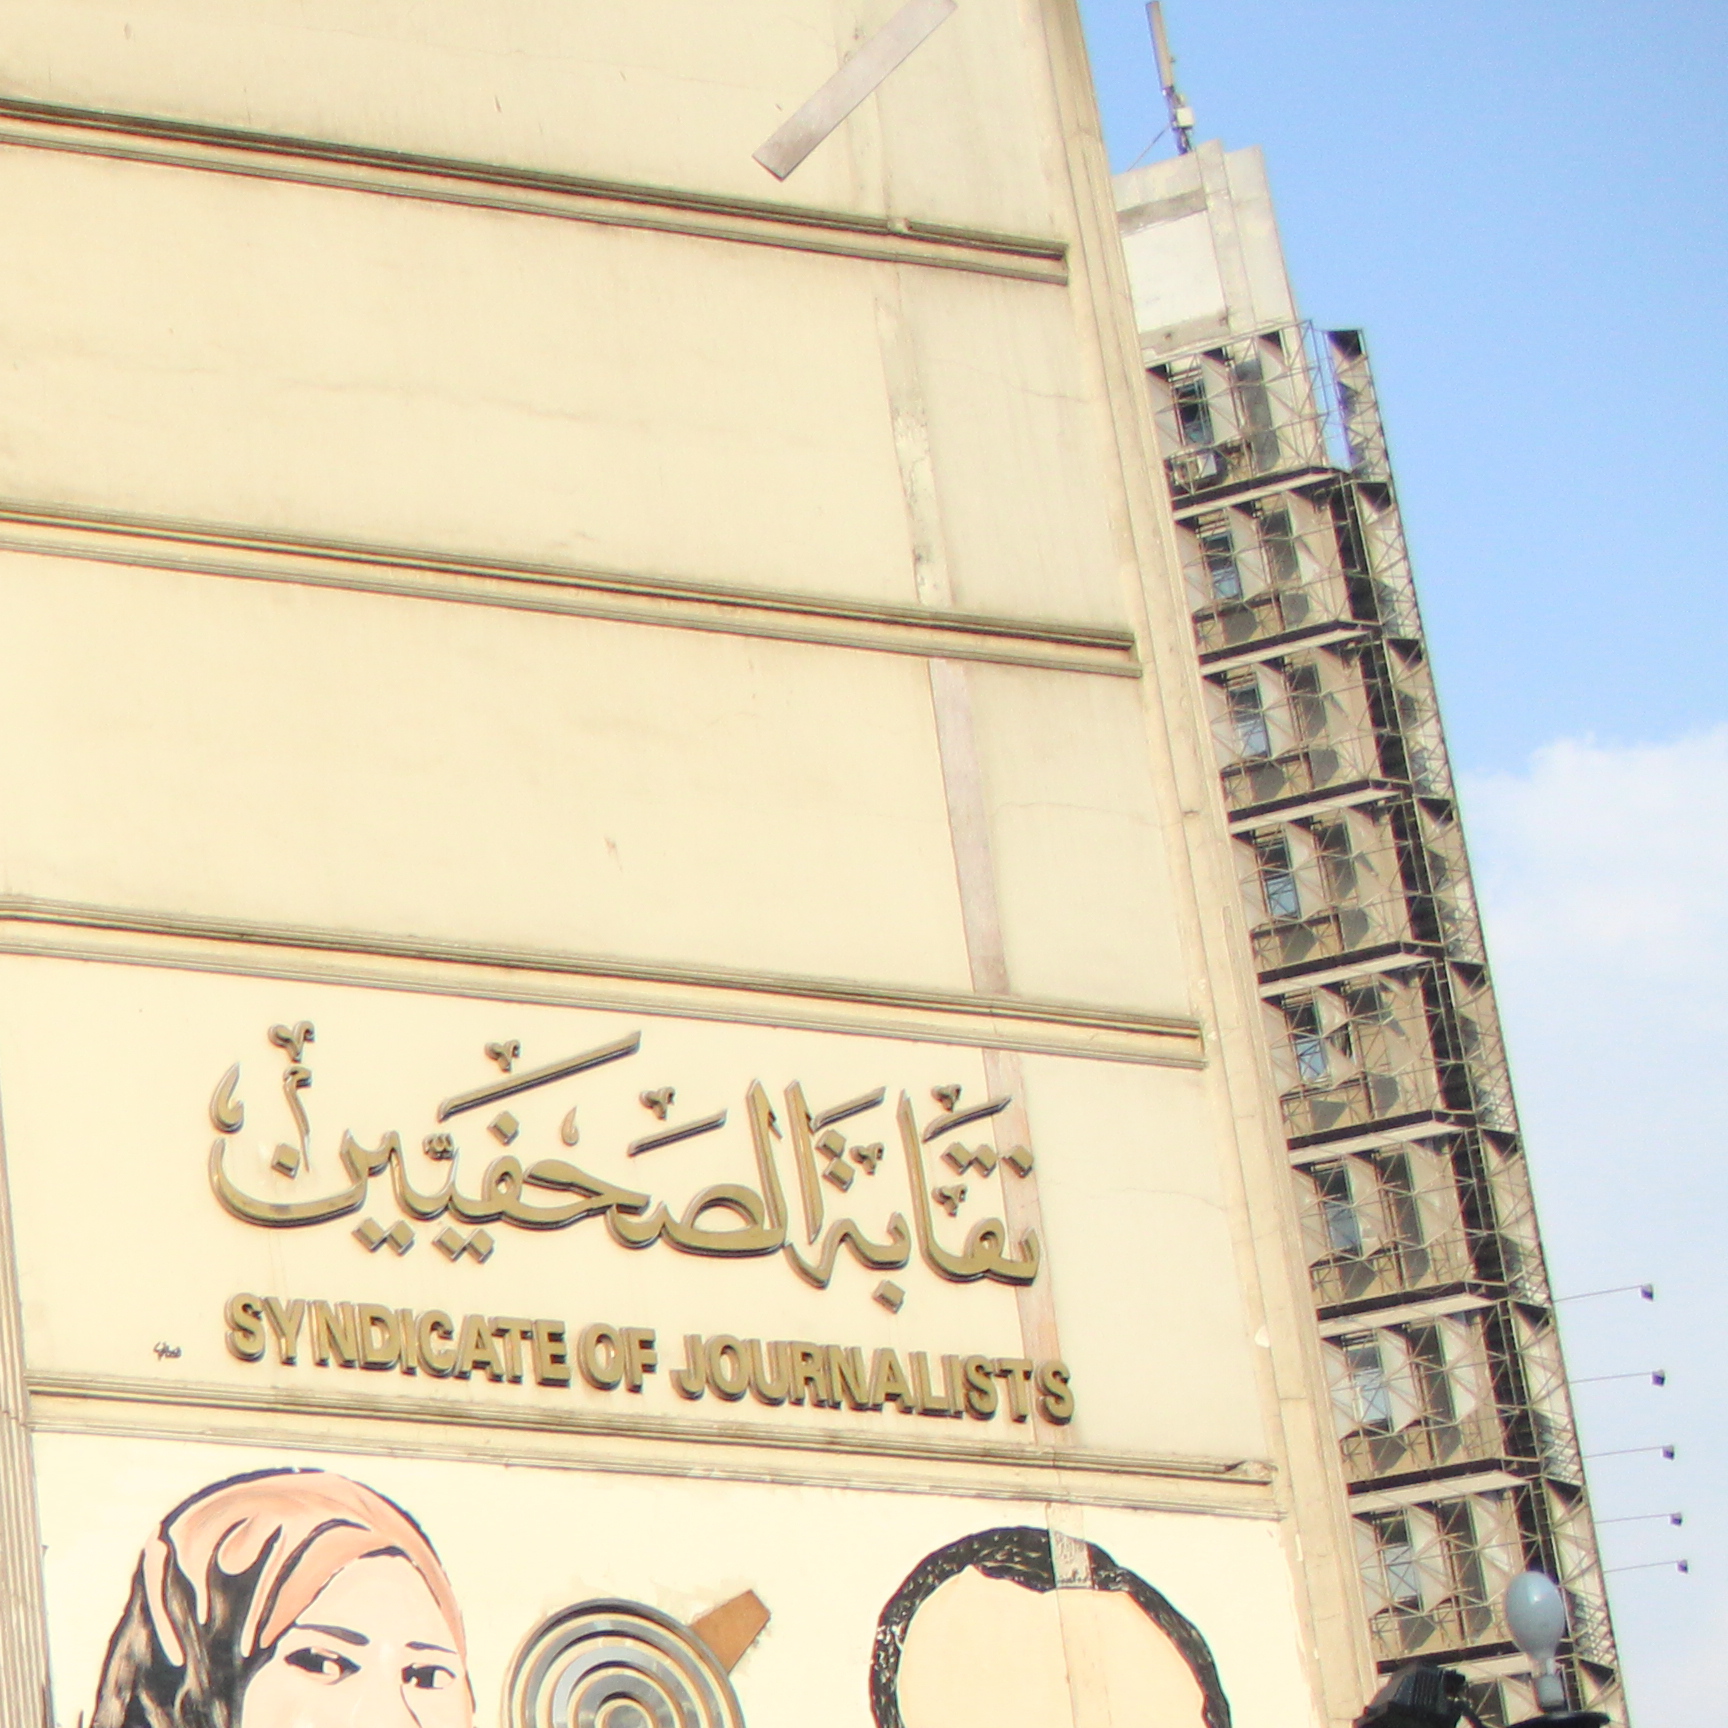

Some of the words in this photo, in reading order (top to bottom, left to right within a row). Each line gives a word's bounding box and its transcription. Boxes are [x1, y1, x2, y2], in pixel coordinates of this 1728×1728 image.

[225, 1291, 572, 1388] SYNDICATE
[577, 1322, 659, 1394] OF
[669, 1333, 1076, 1425] JOURNALISTS
